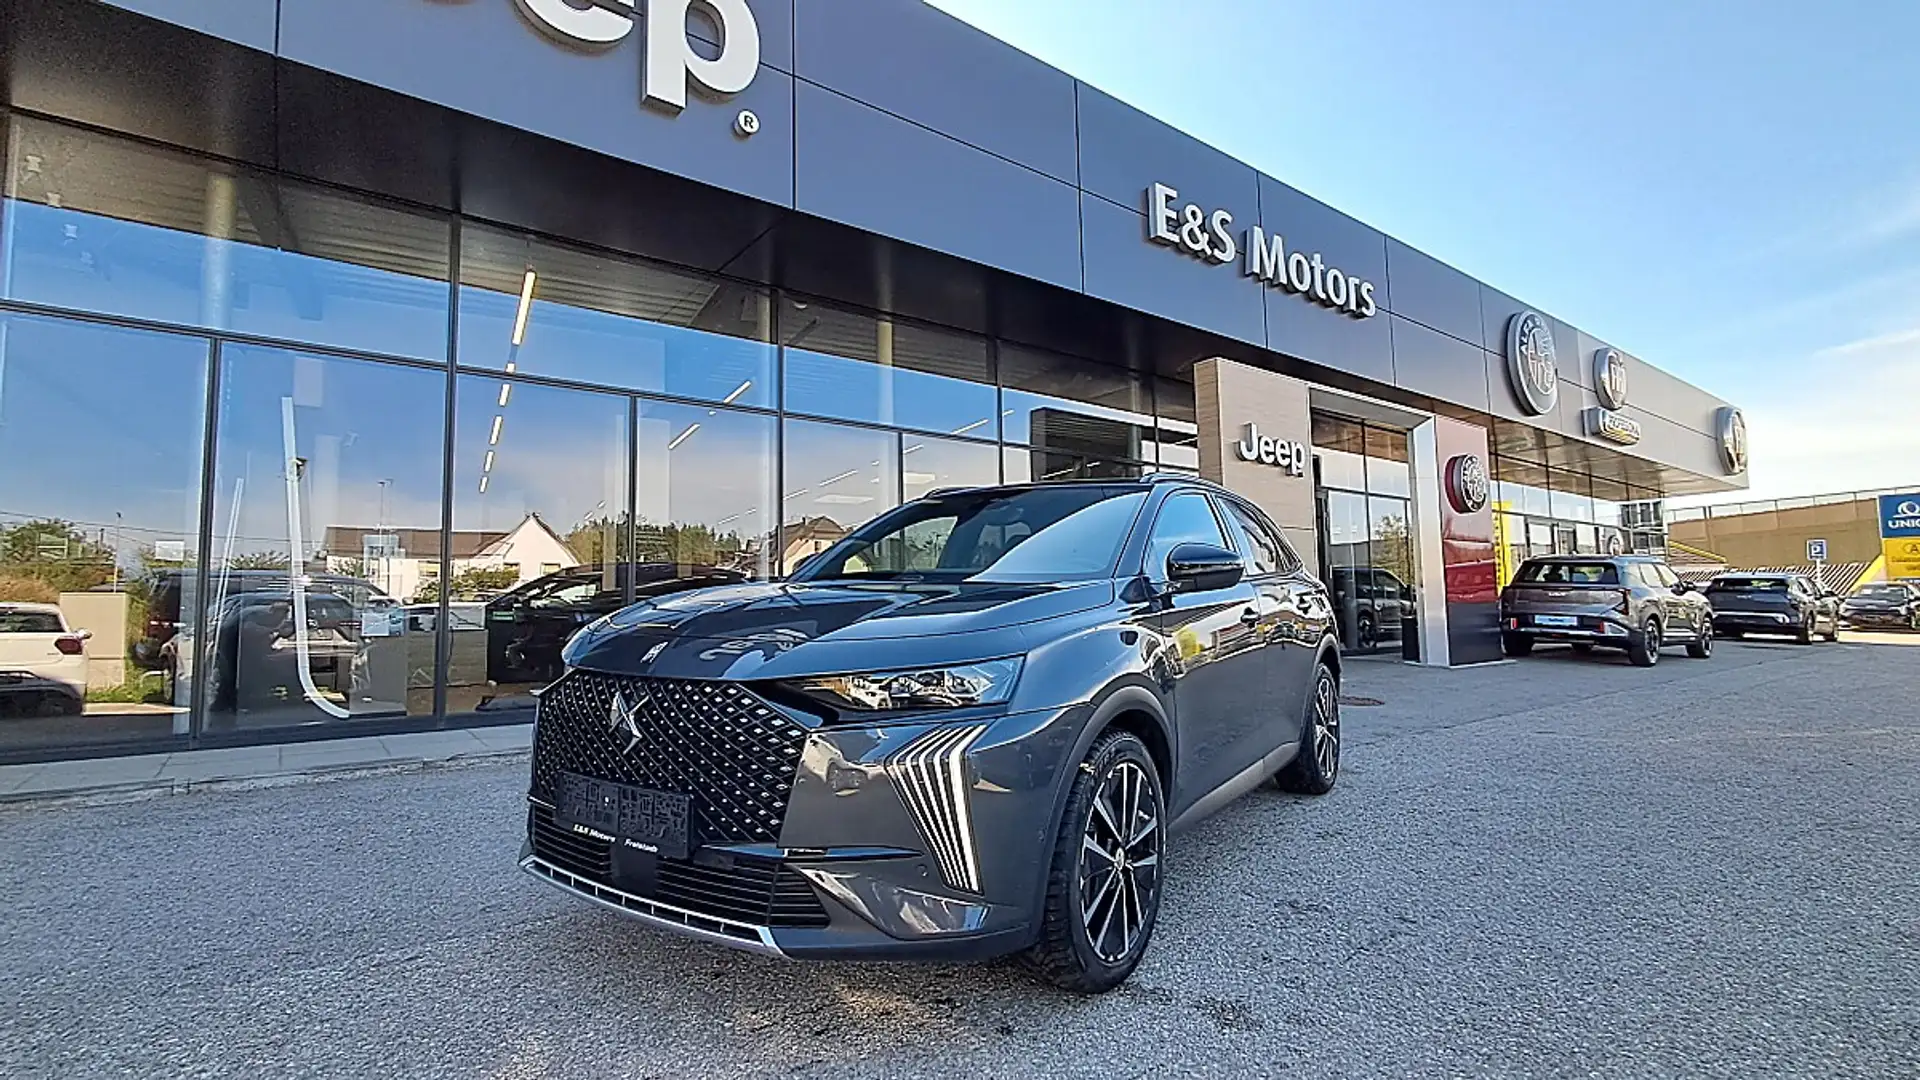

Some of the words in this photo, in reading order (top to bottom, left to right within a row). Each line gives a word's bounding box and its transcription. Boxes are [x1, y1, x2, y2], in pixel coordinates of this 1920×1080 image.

[1148, 182, 1236, 263] E&S
[1246, 226, 1377, 318] Motors
[1237, 422, 1305, 475] Jeep
